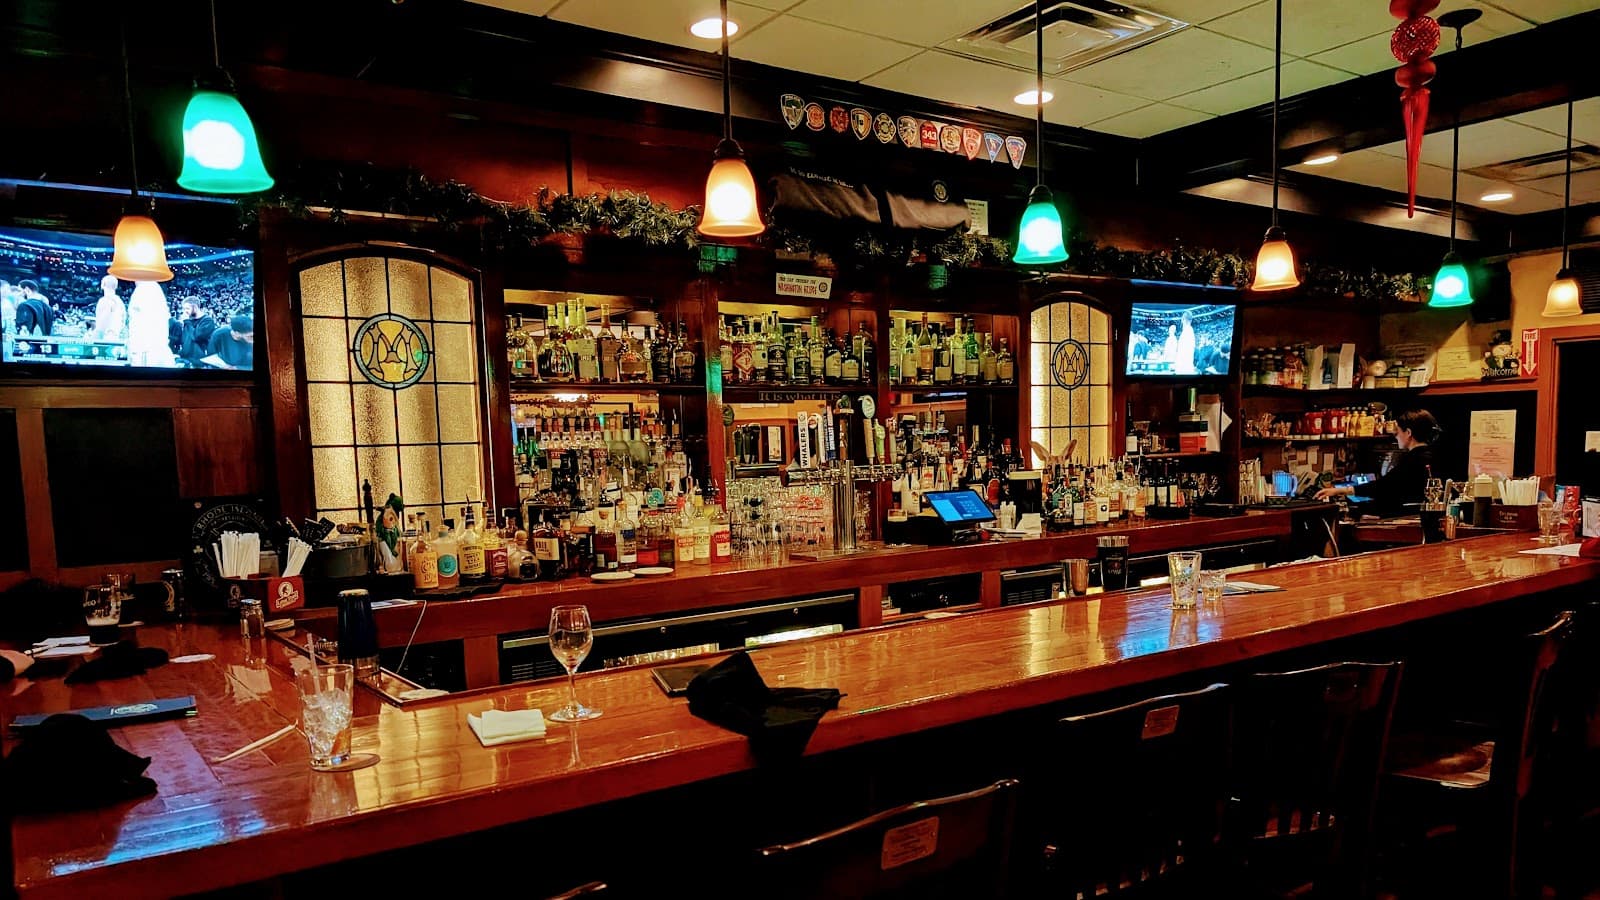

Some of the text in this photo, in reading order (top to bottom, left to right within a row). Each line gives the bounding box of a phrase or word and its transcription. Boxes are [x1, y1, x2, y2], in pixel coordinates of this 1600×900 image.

[921, 130, 937, 140] 343
[759, 391, 768, 401] It
[773, 391, 783, 401] is
[800, 427, 808, 467] WHALERS
[196, 505, 226, 530] RHODE
